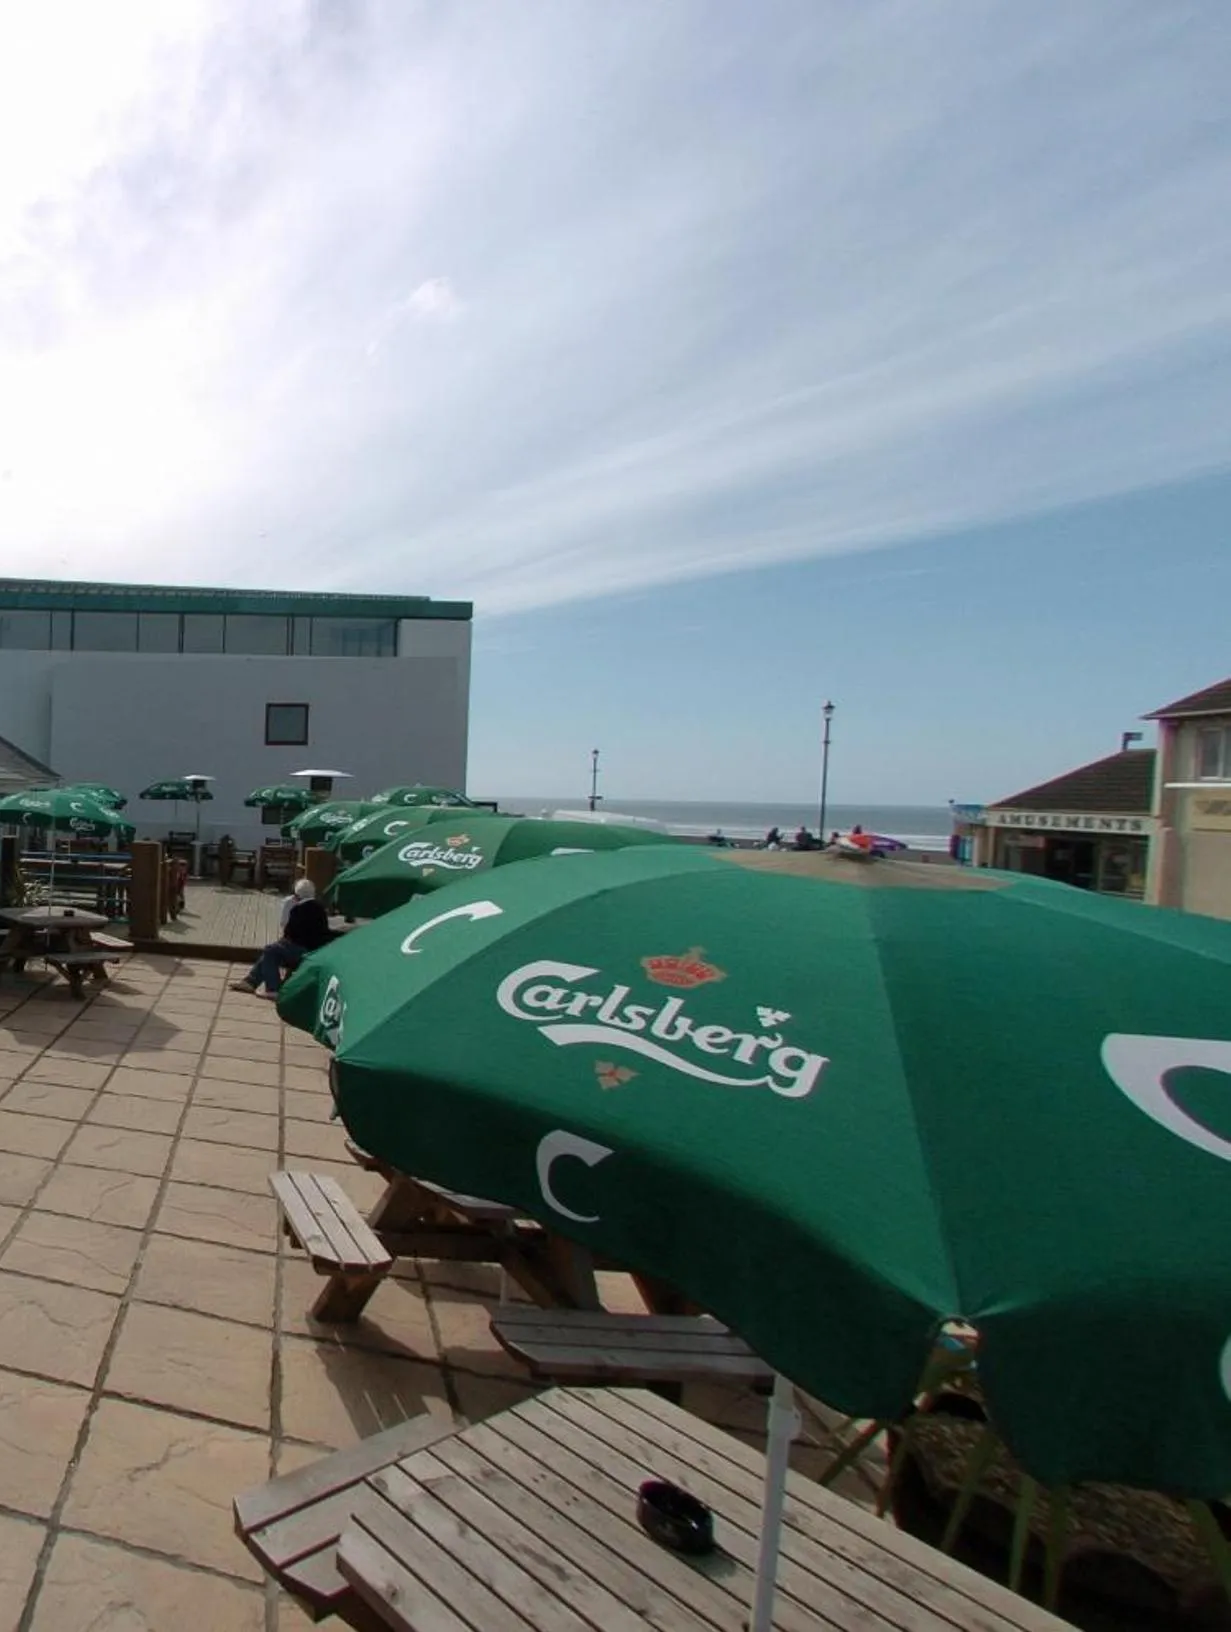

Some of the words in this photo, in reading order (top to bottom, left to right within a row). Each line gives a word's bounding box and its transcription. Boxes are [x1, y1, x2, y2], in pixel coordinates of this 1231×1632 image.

[997, 812, 1143, 831] AMUSEMENTS
[398, 842, 484, 869] Carlsberg
[495, 959, 831, 1099] Carlsberg
[536, 1129, 617, 1224] C
